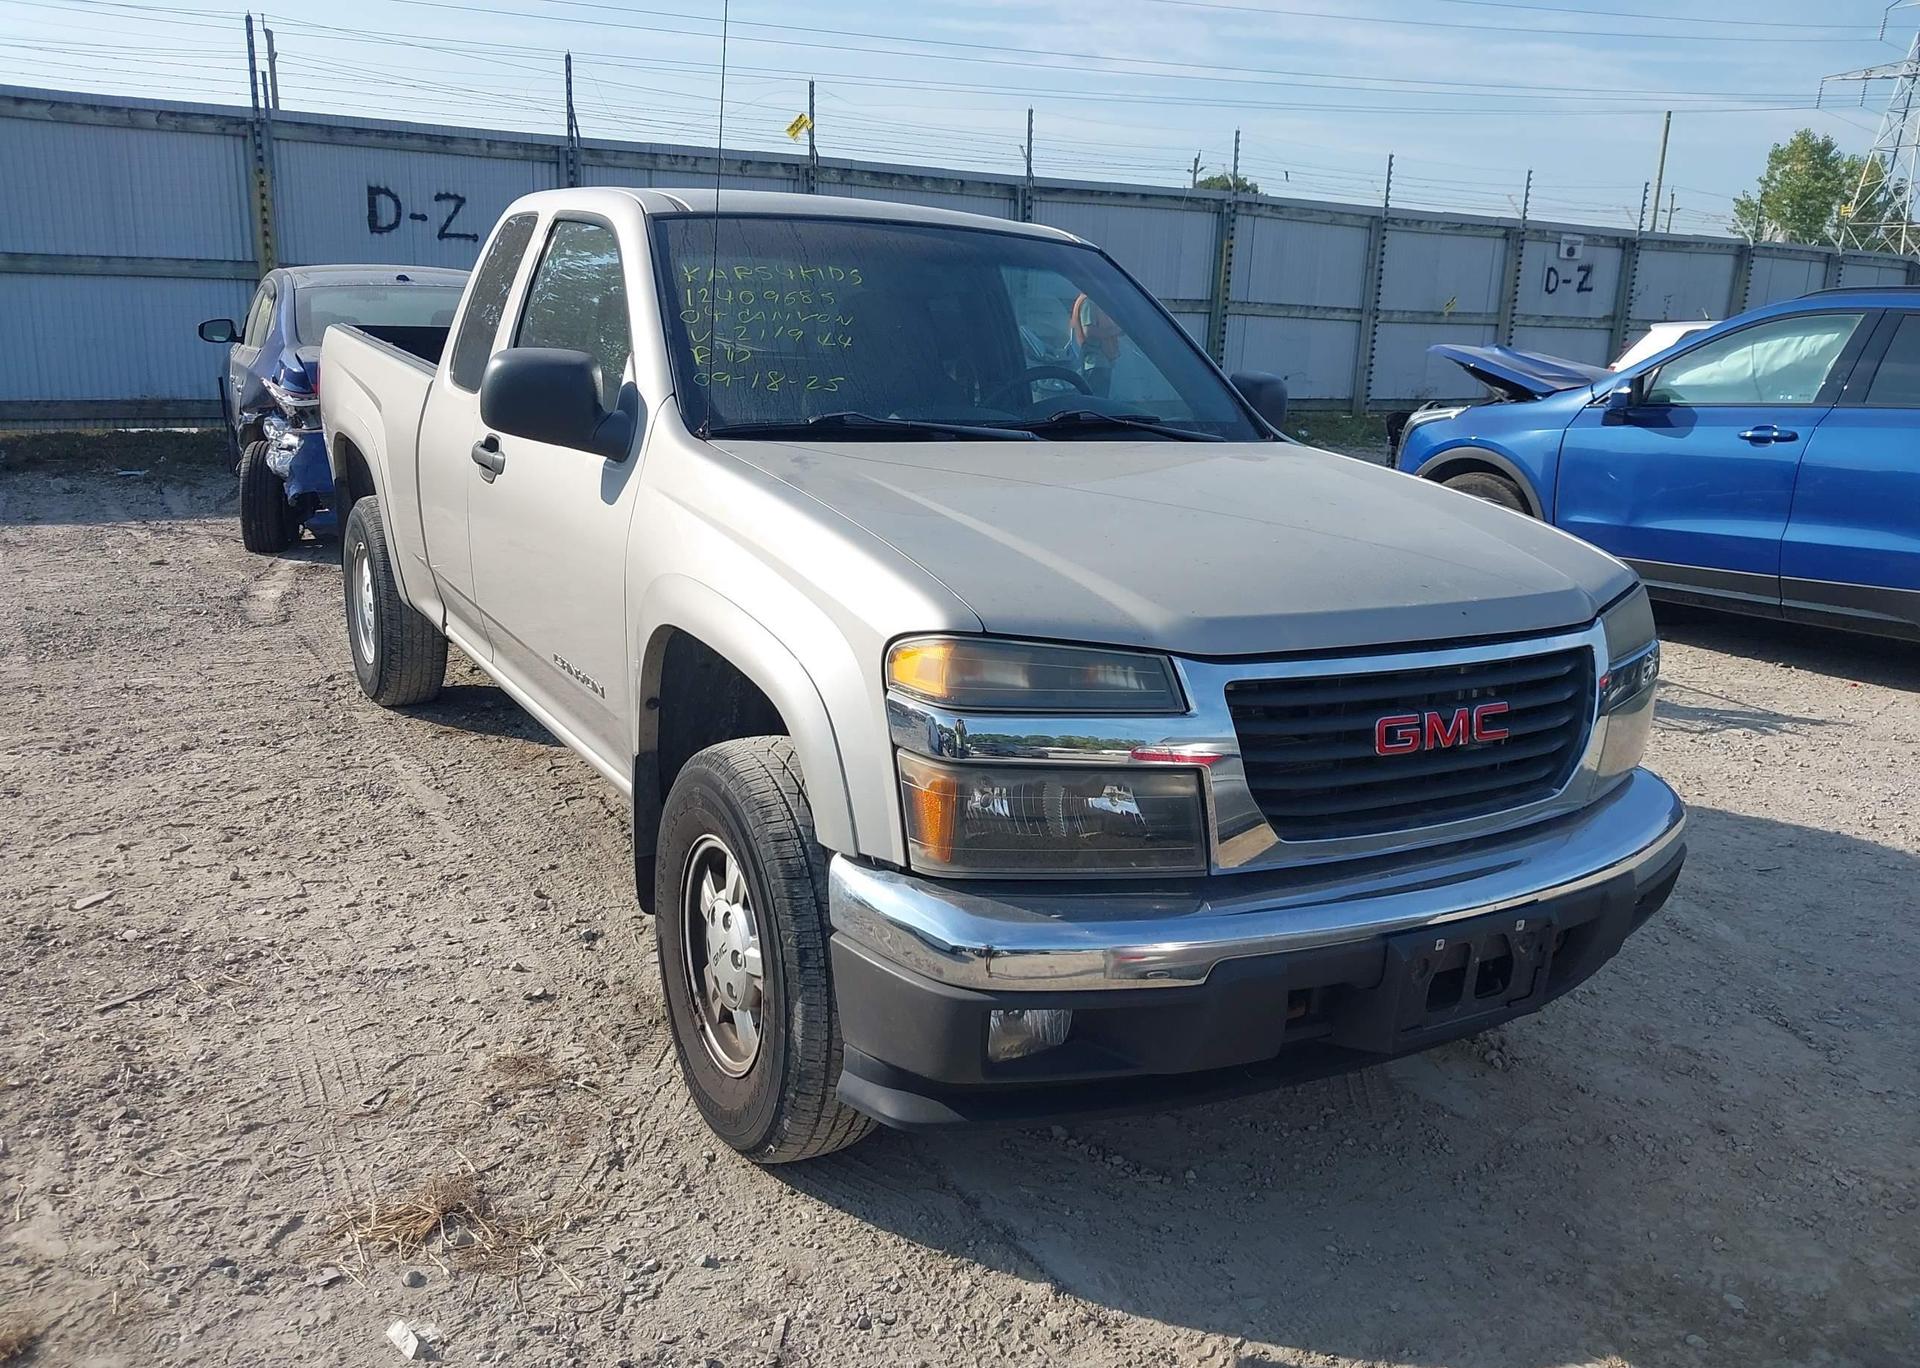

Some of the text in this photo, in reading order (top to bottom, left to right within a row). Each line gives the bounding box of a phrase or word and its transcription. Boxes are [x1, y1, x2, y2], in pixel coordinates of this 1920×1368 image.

[367, 184, 479, 242] D-Z
[682, 264, 863, 285] KARS4KIDS
[1544, 264, 1593, 295] D-Z
[693, 371, 845, 391] 09-18-25
[1375, 701, 1509, 756] GMC
[712, 942, 728, 967] GMC
